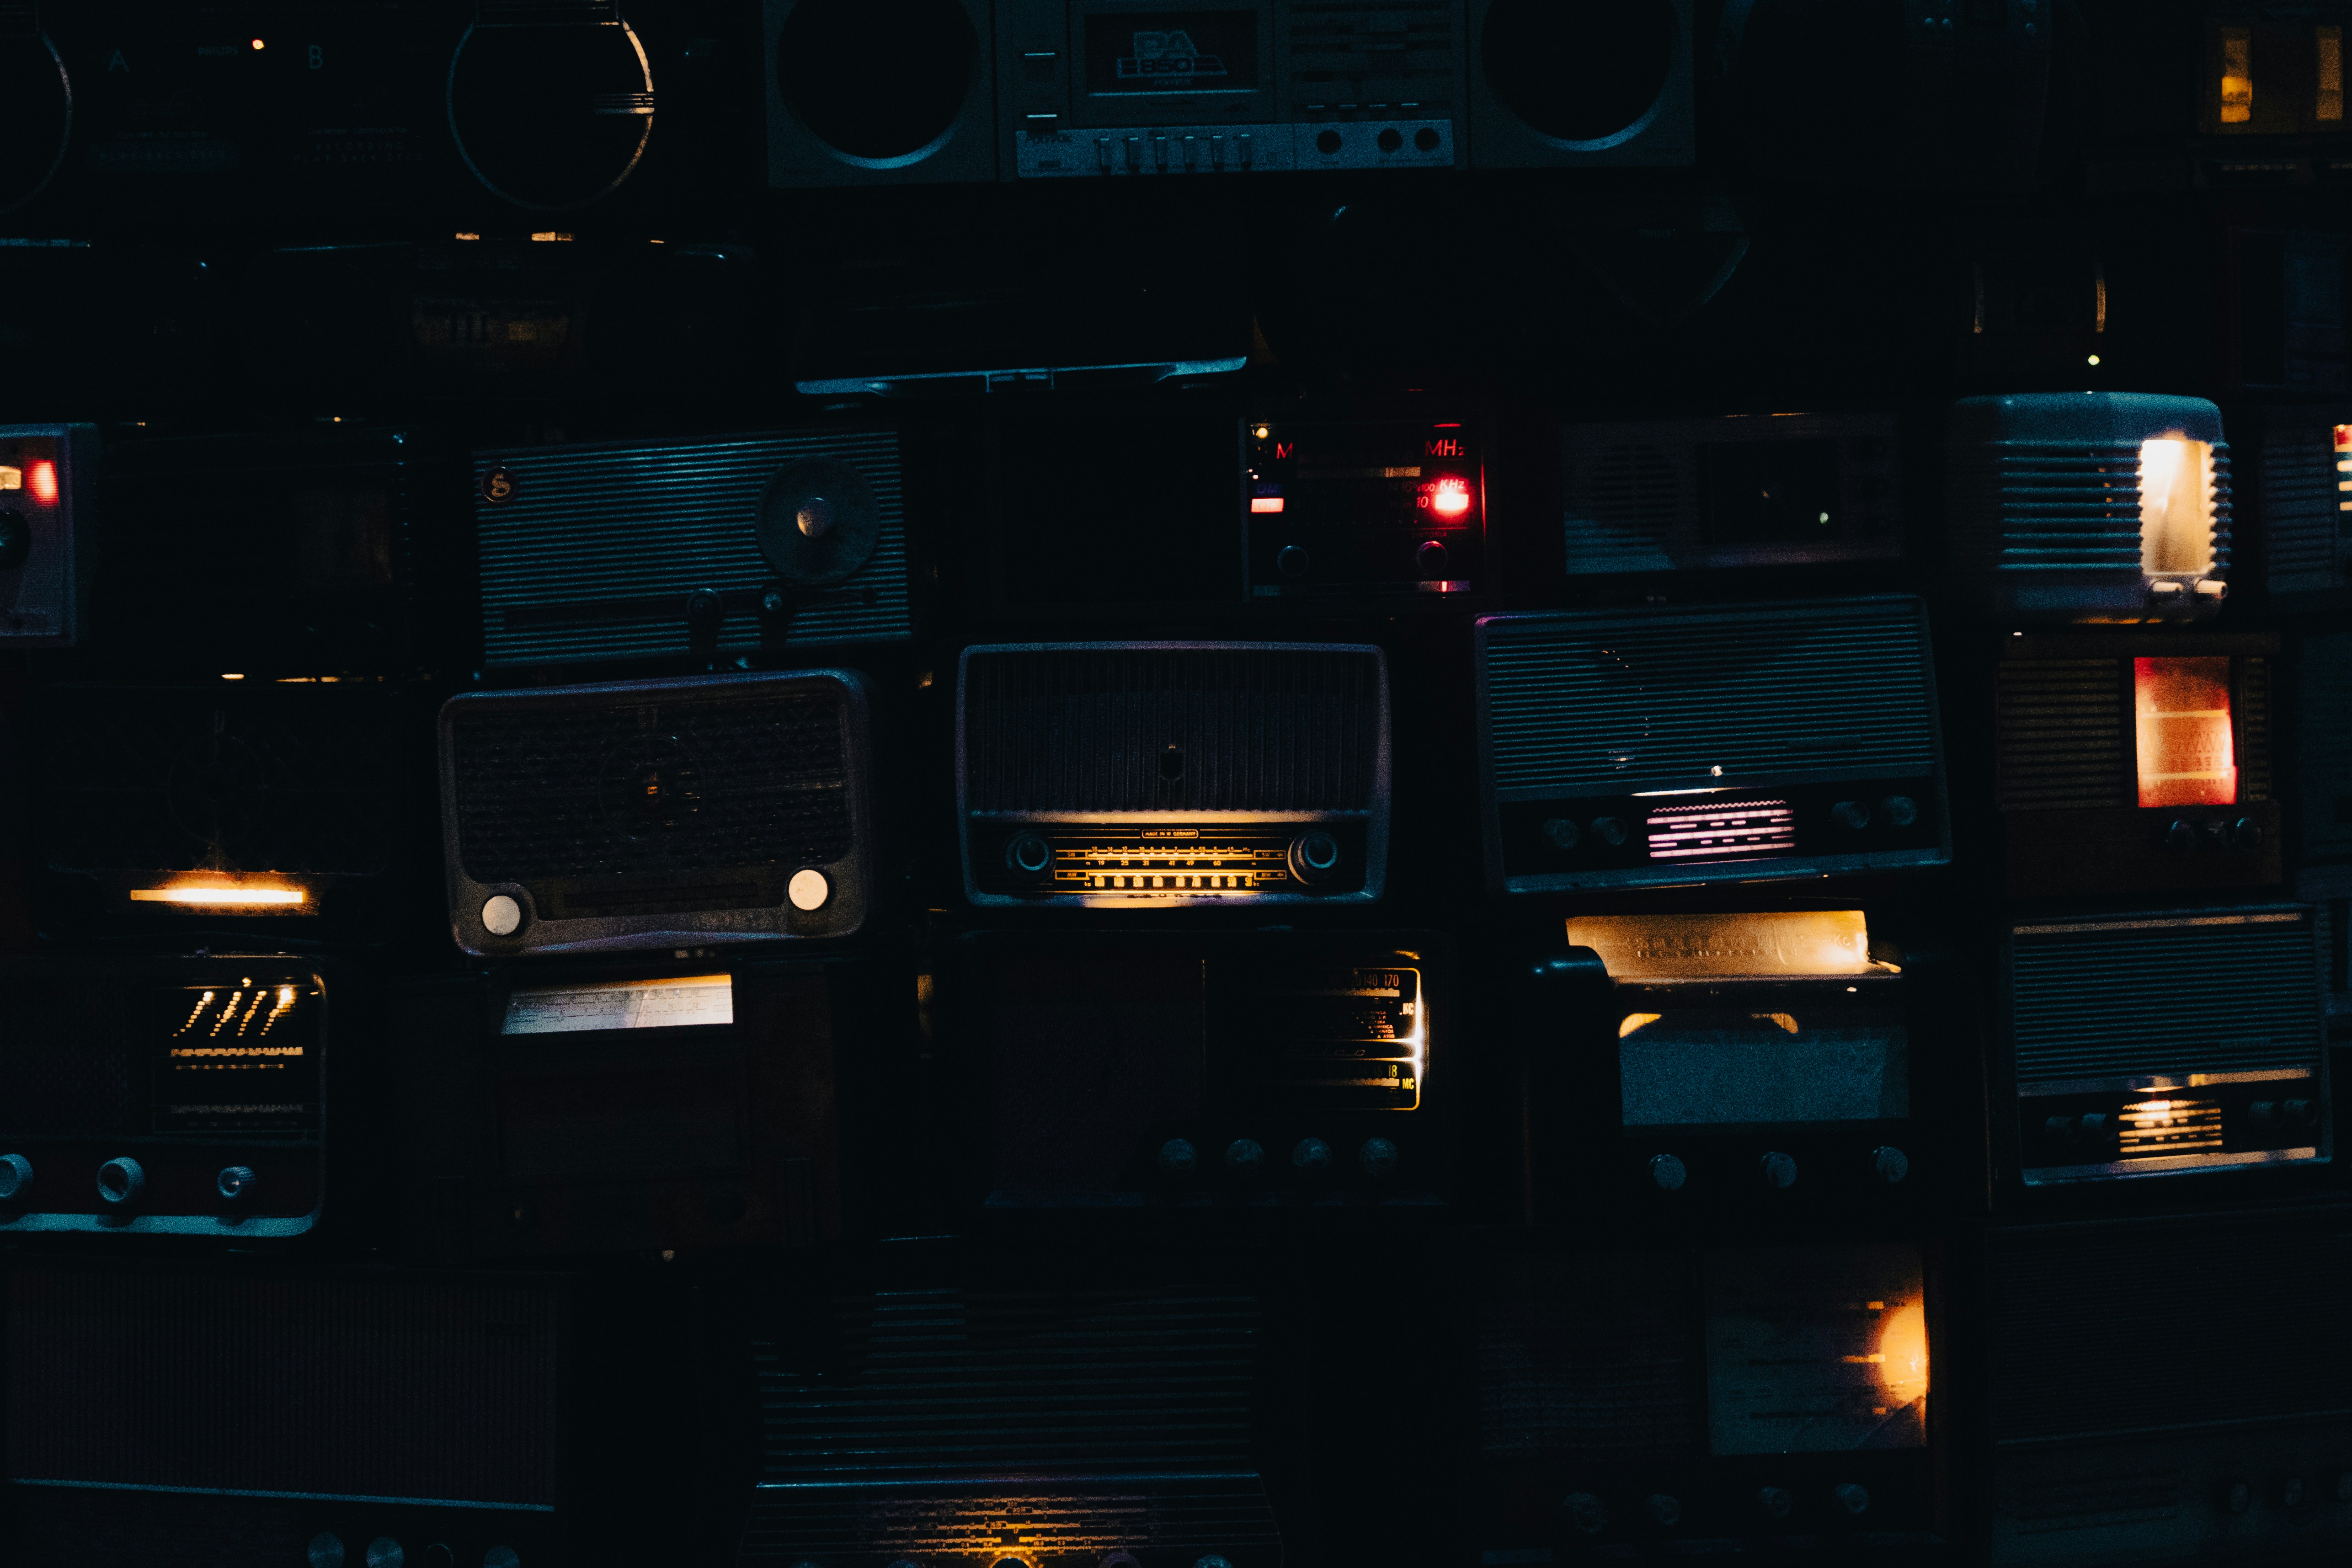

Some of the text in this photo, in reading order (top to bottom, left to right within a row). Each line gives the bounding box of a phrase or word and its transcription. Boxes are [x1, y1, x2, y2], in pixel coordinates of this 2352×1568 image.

[308, 44, 324, 69] B
[1140, 59, 1190, 74] 850
[1425, 438, 1467, 456] MHz
[1440, 479, 1465, 490] KHz
[1364, 974, 1378, 987] 140
[1384, 974, 1399, 987] 170
[1402, 1003, 1414, 1015] KC
[1388, 1064, 1397, 1077] 18
[1402, 1078, 1415, 1090] MC
